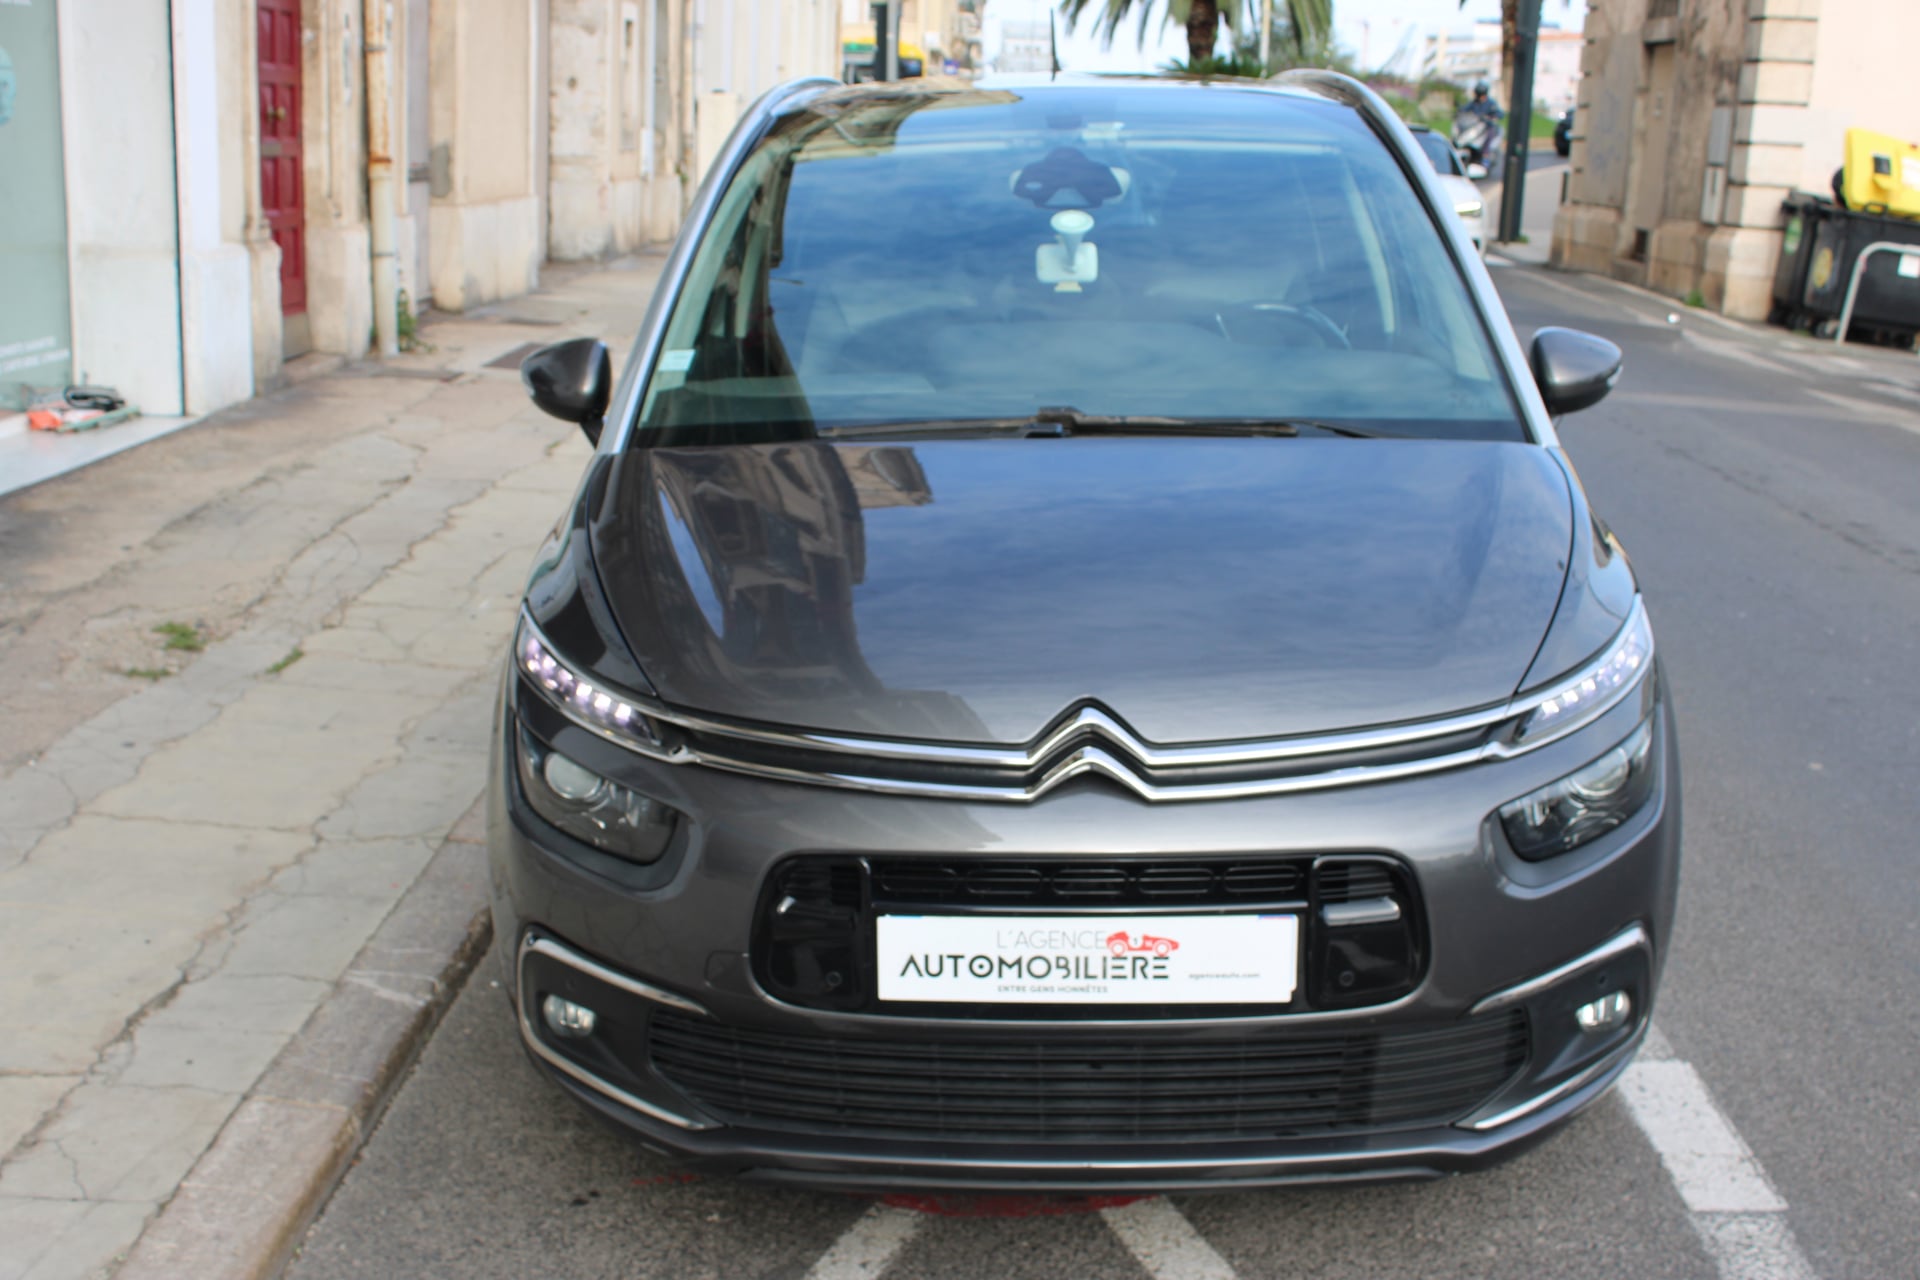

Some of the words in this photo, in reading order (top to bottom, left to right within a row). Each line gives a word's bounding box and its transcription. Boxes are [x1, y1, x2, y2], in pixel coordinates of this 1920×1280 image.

[996, 930, 1107, 950] L'AGENCE
[997, 985, 1027, 993] ENTRE
[1030, 985, 1055, 993] GENS
[1057, 983, 1108, 994] HONNÊTES
